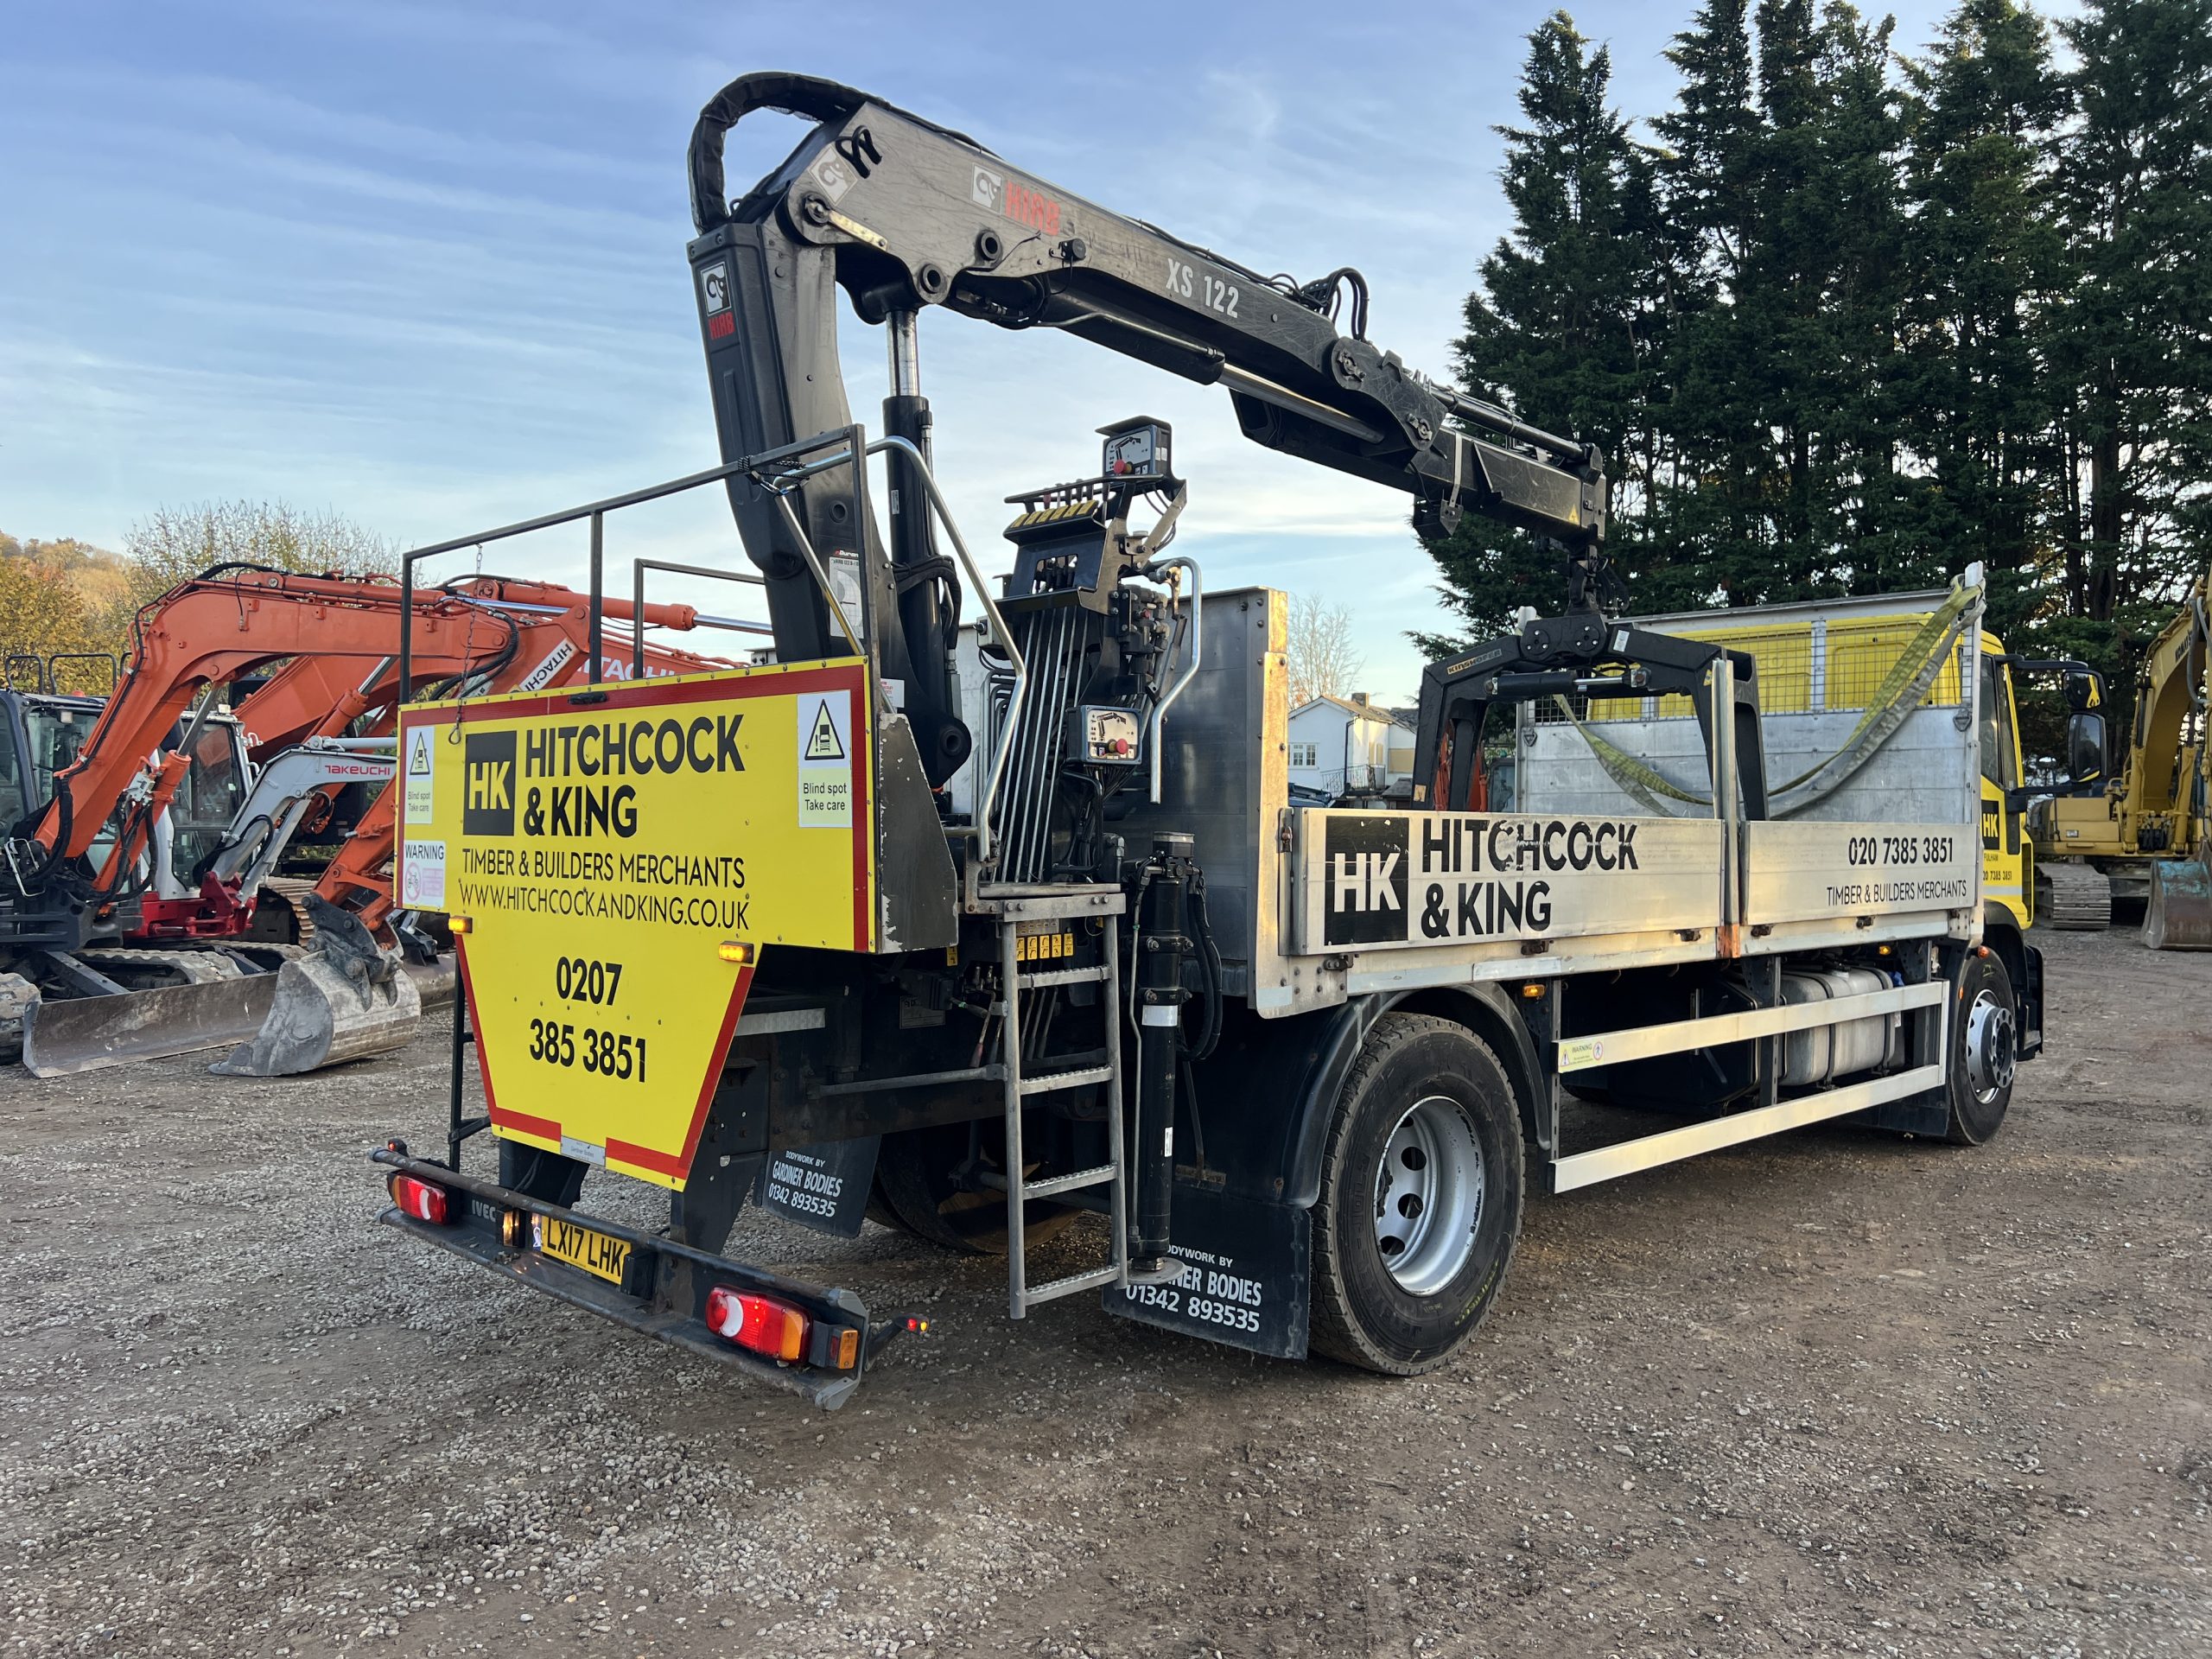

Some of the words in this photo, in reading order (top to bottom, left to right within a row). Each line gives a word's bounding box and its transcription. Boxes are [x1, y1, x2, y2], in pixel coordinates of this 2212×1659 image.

[1005, 180, 1060, 236] HIAB
[1166, 257, 1193, 298] XS
[1205, 276, 1239, 319] 122
[709, 311, 735, 340] HIAB
[524, 643, 572, 691] HITACHI
[525, 715, 746, 778] HITCHCOCK
[468, 760, 511, 810] HK
[804, 782, 825, 794] Blind
[827, 782, 848, 796] spot
[804, 799, 824, 810] Take
[826, 801, 846, 810] care
[524, 786, 545, 836] &
[551, 784, 638, 838] KING
[1982, 813, 1999, 837] HK
[404, 844, 444, 861] WARNING
[1422, 818, 1639, 873] HITCHCOCK
[1848, 836, 1877, 866] 020
[1883, 837, 1917, 865] 7385
[1923, 836, 1953, 863] 3851
[462, 848, 515, 876] TIMBER
[518, 849, 530, 877] &
[534, 850, 614, 882] BUILDERS
[620, 853, 745, 888] MERCHANTS
[1334, 852, 1402, 912] HK
[460, 883, 749, 930] WWW.HITCHCOCKANDKING.CO.UK
[1421, 883, 1451, 939] &
[1458, 880, 1551, 936] KING
[1827, 885, 1862, 906] TIMBER
[1865, 885, 1872, 904] &
[1873, 882, 1915, 902] BUILDERS
[1917, 880, 1967, 899] MERCHANTS
[556, 957, 622, 1006] 0207
[530, 1018, 575, 1067] 385
[582, 1028, 645, 1083] 3851
[772, 1160, 804, 1187] GARDINER
[804, 1170, 843, 1198] BODIES
[785, 1150, 815, 1166] BODYWORK
[815, 1158, 826, 1168] BY
[471, 1198, 497, 1223] IVEC
[768, 1182, 790, 1205] 01342
[791, 1192, 837, 1217] 893535
[547, 1216, 585, 1261] LX17
[588, 1232, 625, 1277] LHK
[1167, 1243, 1216, 1264] DYWORK
[1219, 1255, 1234, 1268] BY
[1126, 1283, 1180, 1313] 01342
[1187, 1296, 1261, 1332] 893535
[1206, 1270, 1262, 1307] BODIES
